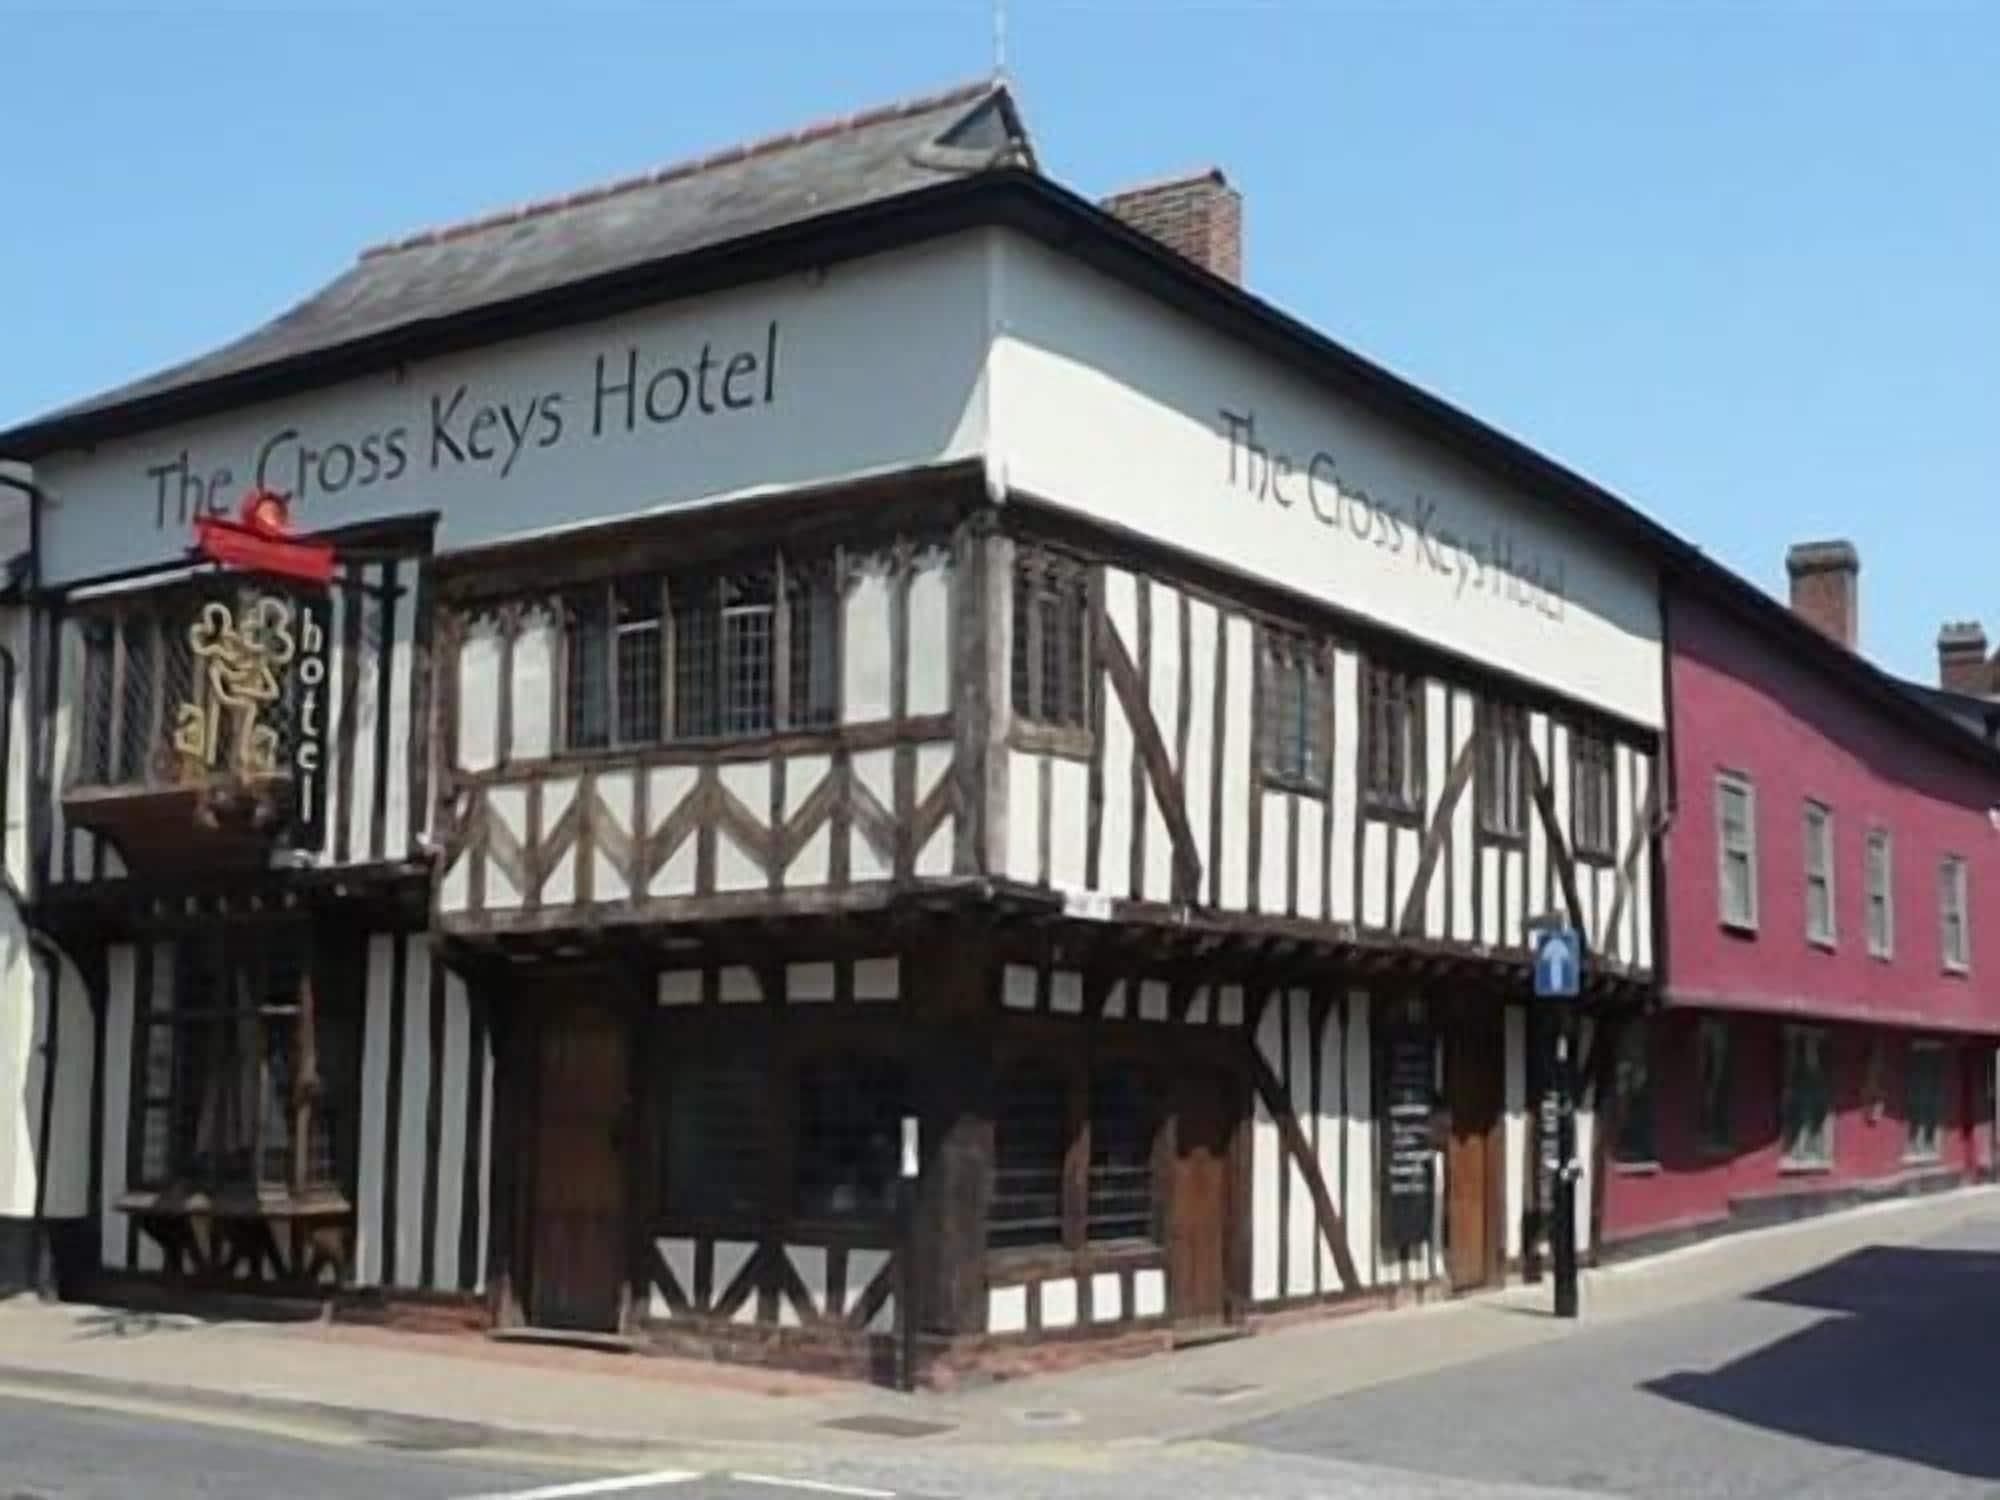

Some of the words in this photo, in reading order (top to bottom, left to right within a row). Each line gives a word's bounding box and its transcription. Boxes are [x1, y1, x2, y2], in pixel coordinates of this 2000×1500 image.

[148, 448, 233, 529] The
[256, 428, 408, 502] Cross
[430, 383, 565, 478] Keys
[592, 320, 776, 436] Hotel
[1219, 408, 1295, 508] The
[1307, 451, 1403, 554] Cross
[1413, 494, 1486, 601] Keys
[297, 606, 325, 824] hotel
